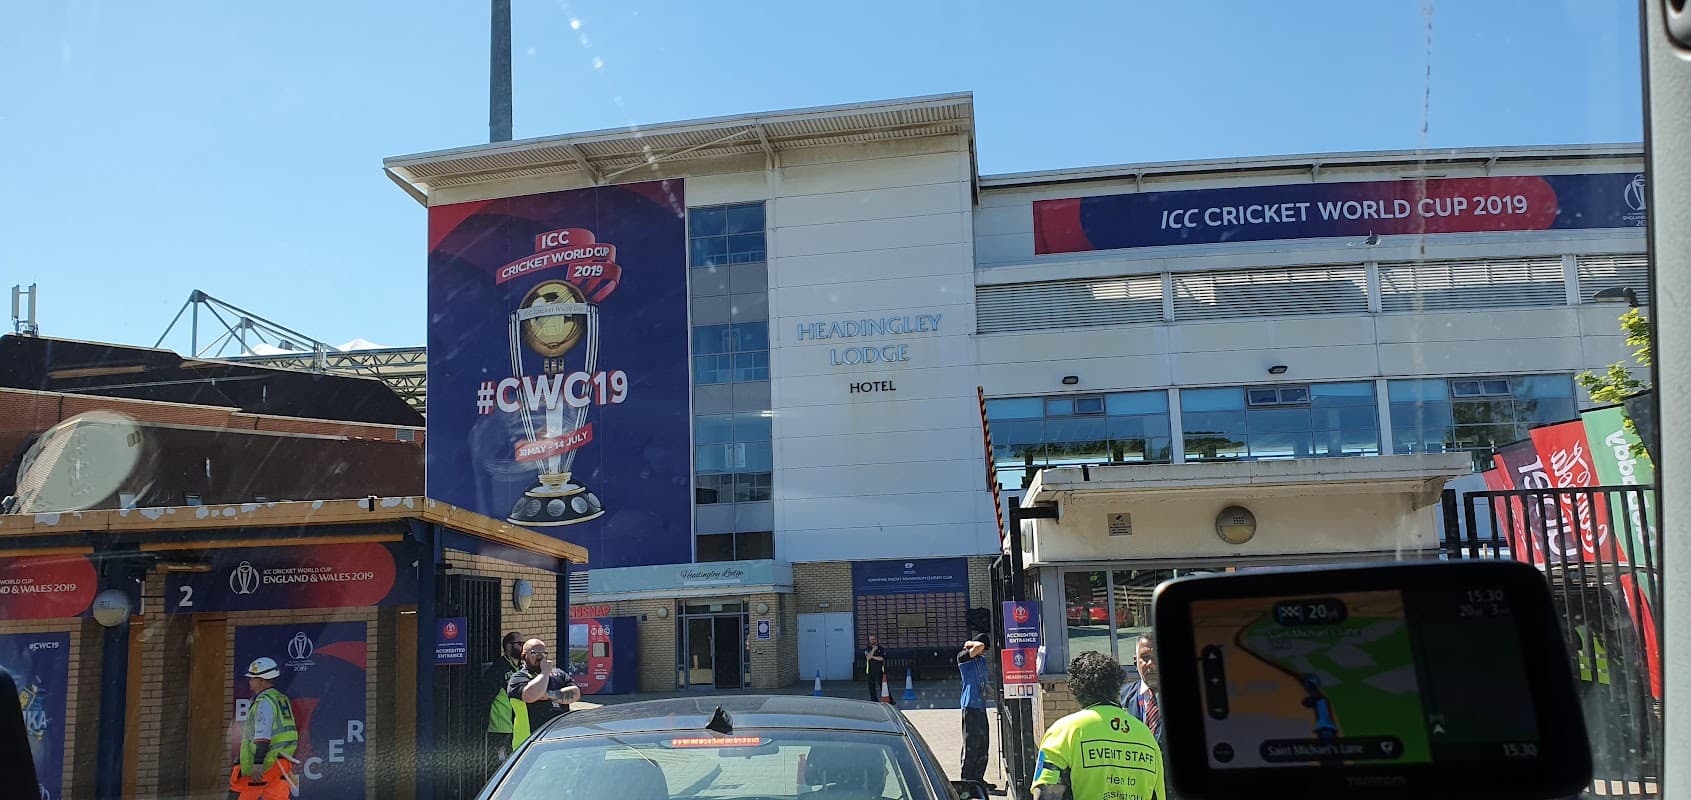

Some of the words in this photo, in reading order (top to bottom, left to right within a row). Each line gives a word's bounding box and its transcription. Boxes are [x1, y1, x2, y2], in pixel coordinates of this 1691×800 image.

[1161, 209, 1199, 230] ICC
[1204, 202, 1310, 227] CRICKET
[1317, 199, 1411, 221] WORLD
[1417, 197, 1467, 217] CUP
[1473, 195, 1528, 215] 2019
[541, 231, 570, 249] ICC
[501, 254, 550, 278] CRICKET
[551, 248, 593, 263] WORLD
[594, 247, 610, 257] CUP
[573, 265, 603, 277] 2019
[797, 313, 942, 341] HEADINGLEY
[830, 343, 912, 366] LODGE
[476, 370, 628, 414] #CWC19
[850, 380, 896, 393] HOTEL
[555, 441, 564, 449] 14
[565, 431, 588, 446] JULY
[263, 575, 309, 583] ENGLAND
[310, 574, 318, 582] &
[319, 573, 351, 581] WALES
[352, 572, 374, 580] 2019
[11, 585, 20, 594] &
[20, 584, 52, 593] WALES
[53, 583, 76, 592] 2019
[179, 585, 193, 606] 2
[29, 641, 59, 651] #CWC19
[1088, 748, 1122, 760] EVENT
[1125, 750, 1154, 765] STAFF
[1127, 776, 1136, 786] to
